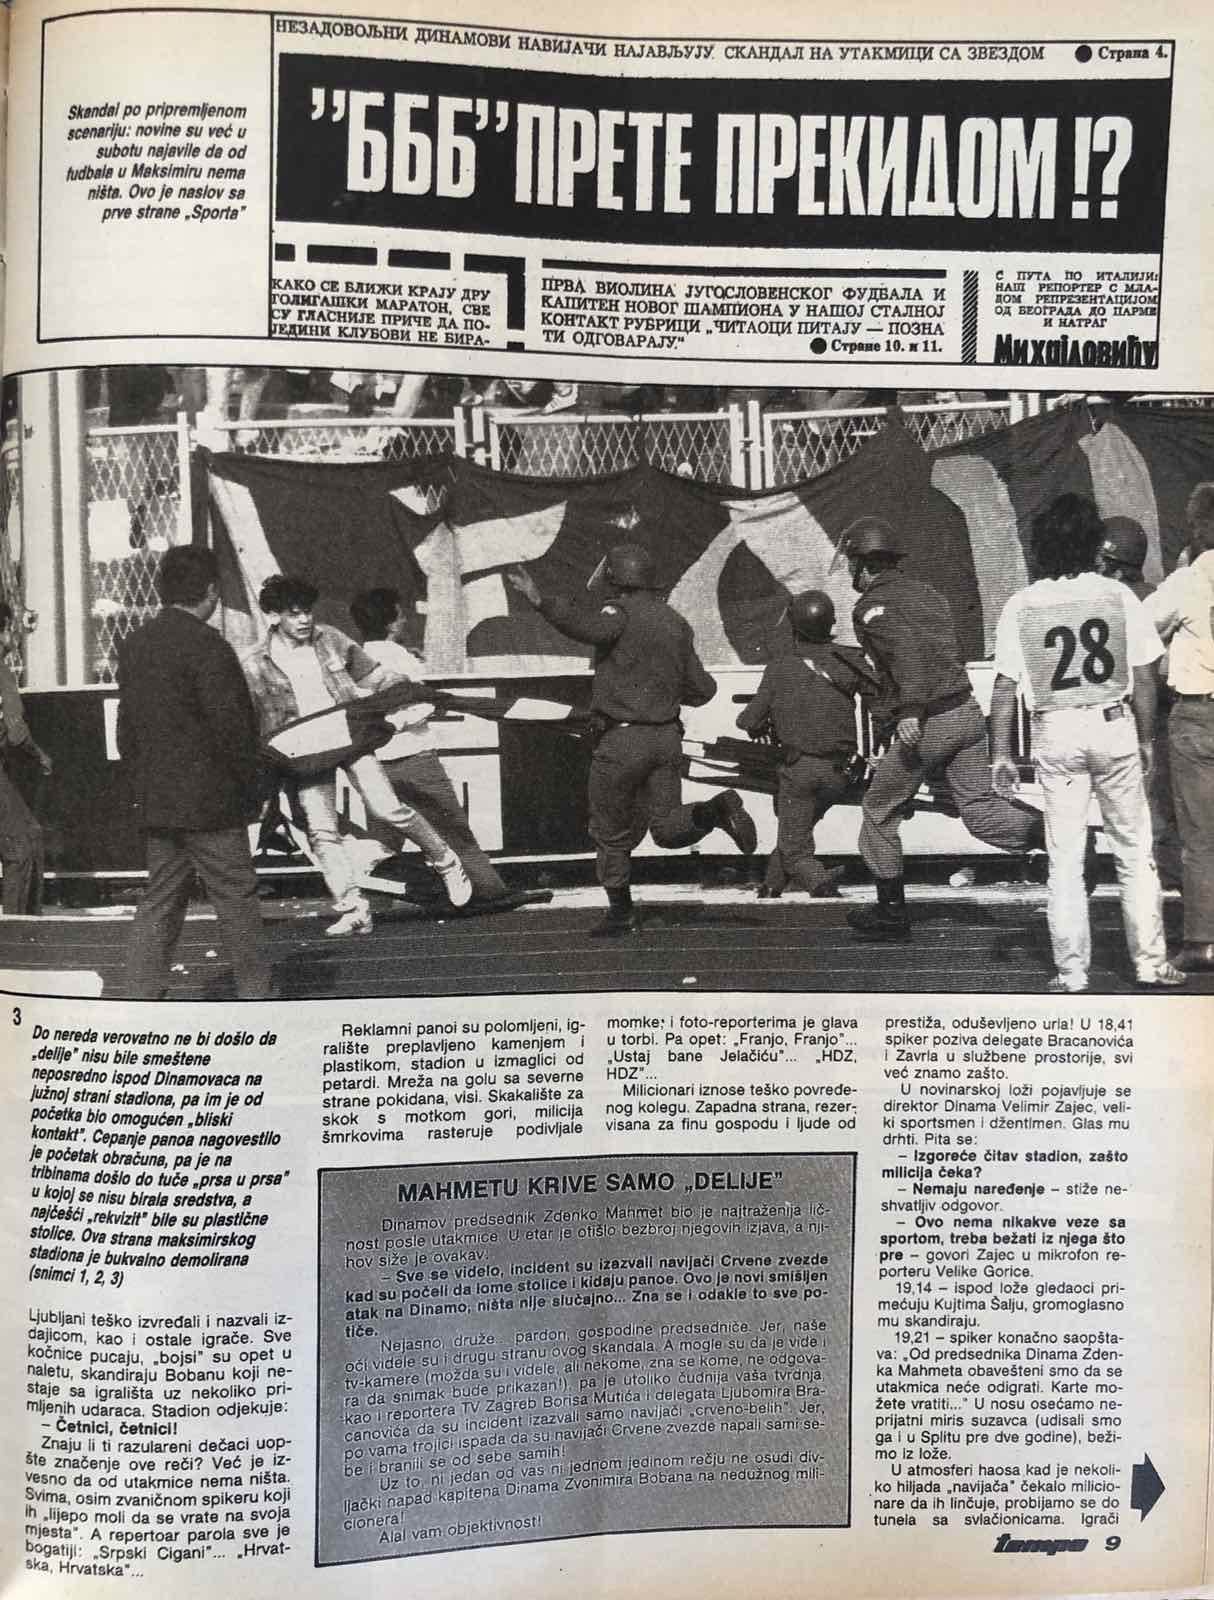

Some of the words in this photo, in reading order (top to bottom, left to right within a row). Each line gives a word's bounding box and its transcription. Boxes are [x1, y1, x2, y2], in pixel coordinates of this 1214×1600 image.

[276, 19, 408, 41] НЕЗАДОВОЉНИ
[414, 24, 513, 49] ДИНАМОВИ
[518, 34, 608, 56] НАВИЈАЧИ
[724, 45, 804, 62] СКАНДАЛ
[809, 46, 833, 60] НА
[839, 46, 934, 63] УТАКМИЦИ
[939, 46, 962, 60] СА
[967, 46, 1045, 63] ЗВЕЗДОМ
[1098, 46, 1149, 62] Страна
[1155, 45, 1168, 58] 4.
[68, 102, 120, 120] Skandal
[122, 105, 141, 120] po
[145, 102, 247, 120] pripremljenom
[67, 123, 131, 141] scenariju:
[135, 122, 181, 137] novine
[185, 126, 203, 137] su
[209, 123, 233, 138] već
[237, 128, 247, 139] u
[96, 143, 143, 159] subotu
[147, 143, 201, 161] najavile
[205, 144, 223, 159] da
[228, 145, 247, 159] od
[514, 103, 692, 217] ПРЕТЕ
[715, 113, 1058, 220] ПРЕКИДОМ
[118, 167, 127, 178] u
[131, 163, 202, 178] Maksimiru
[207, 168, 246, 180] nema
[88, 185, 122, 200] ništa.
[129, 184, 156, 199] Ovo
[158, 184, 173, 202] je
[178, 184, 224, 199] naslov
[228, 188, 245, 200] sa
[101, 208, 132, 223] prve
[136, 205, 180, 219] strane
[996, 270, 1004, 281] С
[1017, 271, 1051, 281] ПУТА
[1065, 270, 1082, 281] ПО
[1096, 271, 1159, 281] ИТАЛИЈИ:
[272, 278, 314, 291] КАКО
[320, 280, 339, 292] СЕ
[345, 281, 402, 296] БЛИЖИ
[408, 285, 456, 299] КРАЈУ
[461, 288, 491, 302] ДРУ
[541, 276, 586, 295] ПРВА
[595, 281, 676, 297] ВИОЛИНА
[685, 285, 832, 300] ЈУГОСЛОВЕНСКОГ
[842, 287, 923, 303] ФУДБАЛА
[933, 288, 946, 301] И
[995, 282, 1025, 292] НАШ
[1038, 283, 1102, 293] РЕПОРТЕР
[1109, 283, 1118, 293] С
[1125, 284, 1158, 293] МЛА-
[376, 297, 453, 314] МАРАТОН,
[462, 304, 491, 316] СВЕ
[542, 295, 620, 312] КАПИТЕН
[625, 300, 679, 315] НОВОГ
[684, 301, 783, 317] ШАМПИОНА
[789, 304, 800, 317] У
[806, 304, 865, 317] НАШОЈ
[870, 305, 945, 318] СТАЛНОЈ
[995, 294, 1022, 304] ДОМ
[1036, 295, 1158, 305] РЕПРЕЗЕНТАЦИЈОМ
[272, 309, 291, 321] СУ
[297, 309, 375, 324] ГЛАСНИЈЕ
[381, 313, 432, 327] ПРИЧЕ
[437, 317, 459, 330] ДА
[464, 319, 490, 331] ПО-
[995, 305, 1011, 317] ОД
[1018, 305, 1082, 317] БЕОГРАДА
[1088, 306, 1106, 317] ДО
[1114, 307, 1157, 316] ПАРМЕ
[541, 312, 619, 329] КОНТАКТ
[624, 317, 700, 335] РУБРИЦИ
[706, 320, 792, 336] „ЧИТАОЦИ
[797, 321, 862, 335] ПИТАЈУ
[888, 322, 944, 336] ПОЗНА
[1043, 318, 1053, 327] И
[1058, 318, 1107, 328] НАТРАГ
[271, 323, 331, 337] ЈЕДИНИ
[339, 326, 411, 342] КЛУБОВИ
[418, 331, 438, 343] НЕ
[445, 332, 490, 346] БИРА-
[542, 329, 565, 343] ТИ
[831, 339, 881, 354] Стране
[885, 340, 905, 352] 10.
[909, 343, 919, 352] и
[923, 340, 942, 352] 11.
[1043, 617, 1115, 691] 28
[13, 1007, 21, 1026] 3
[886, 1016, 945, 1031] prestiža,
[952, 1017, 1037, 1032] oduševljeno
[1043, 1018, 1073, 1030] urla!
[1081, 1018, 1091, 1030] U
[1098, 1018, 1132, 1032] 18,41
[32, 1025, 50, 1040] Do
[54, 1028, 98, 1043] nereda
[103, 1032, 169, 1045] verovatno
[174, 1034, 192, 1045] ne
[196, 1031, 211, 1046] bi
[214, 1031, 254, 1046] došlo
[259, 1031, 277, 1046] da
[342, 1022, 411, 1037] Reklamni
[417, 1021, 457, 1038] panoi
[462, 1024, 479, 1033] su
[485, 1018, 561, 1036] polomljeni,
[567, 1018, 585, 1034] ig-
[608, 1050, 650, 1065] „Ustaj
[668, 1050, 702, 1062] bane
[914, 1149, 976, 1165] Izgoreće
[984, 1149, 1018, 1162] čitav
[1025, 1150, 1081, 1163] stadion,
[1089, 1150, 1128, 1162] zašto
[882, 1166, 932, 1181] milicija
[938, 1166, 982, 1178] čeka?
[398, 1176, 519, 1204] MAHMETU
[529, 1173, 598, 1197] KRIVE
[606, 1171, 676, 1192] SAMO
[29, 1245, 84, 1263] stadiona
[86, 1249, 101, 1267] je
[104, 1250, 165, 1267] bukvalno
[170, 1252, 249, 1267] demolirana
[56, 1416, 113, 1436] Četnici,
[120, 1421, 177, 1435] četnici!
[874, 1514, 916, 1526] tunela
[933, 1516, 948, 1526] sa
[964, 1512, 1064, 1525] svlačionicama.
[1081, 1512, 1119, 1527] Igrači
[379, 1525, 406, 1544] Alal
[412, 1526, 443, 1542] vam
[448, 1515, 542, 1536] objektivnost!
[1105, 1536, 1121, 1551] 9
[25, 1557, 53, 1574] ska,
